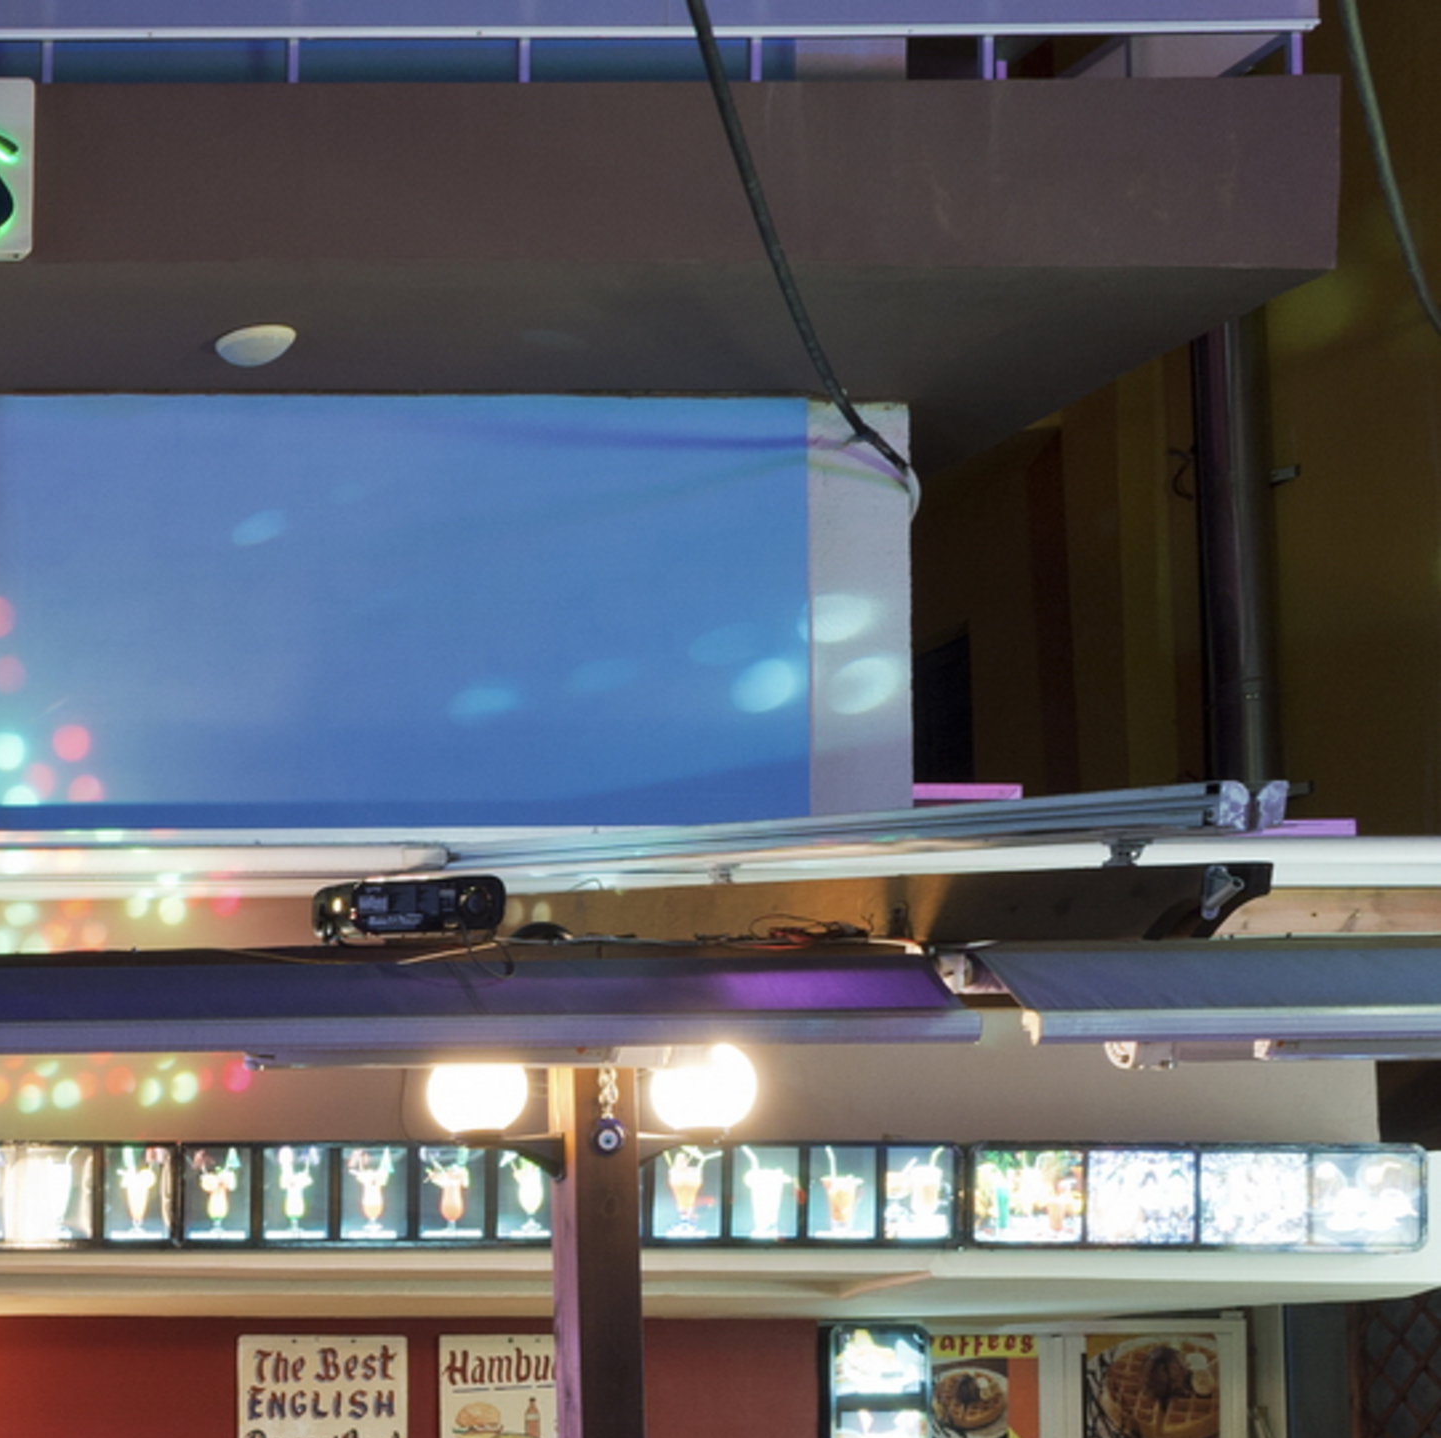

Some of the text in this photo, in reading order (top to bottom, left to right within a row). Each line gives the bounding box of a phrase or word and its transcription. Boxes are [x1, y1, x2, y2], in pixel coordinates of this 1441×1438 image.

[254, 1344, 398, 1383] The Best
[247, 1385, 396, 1421] ENGLISH
